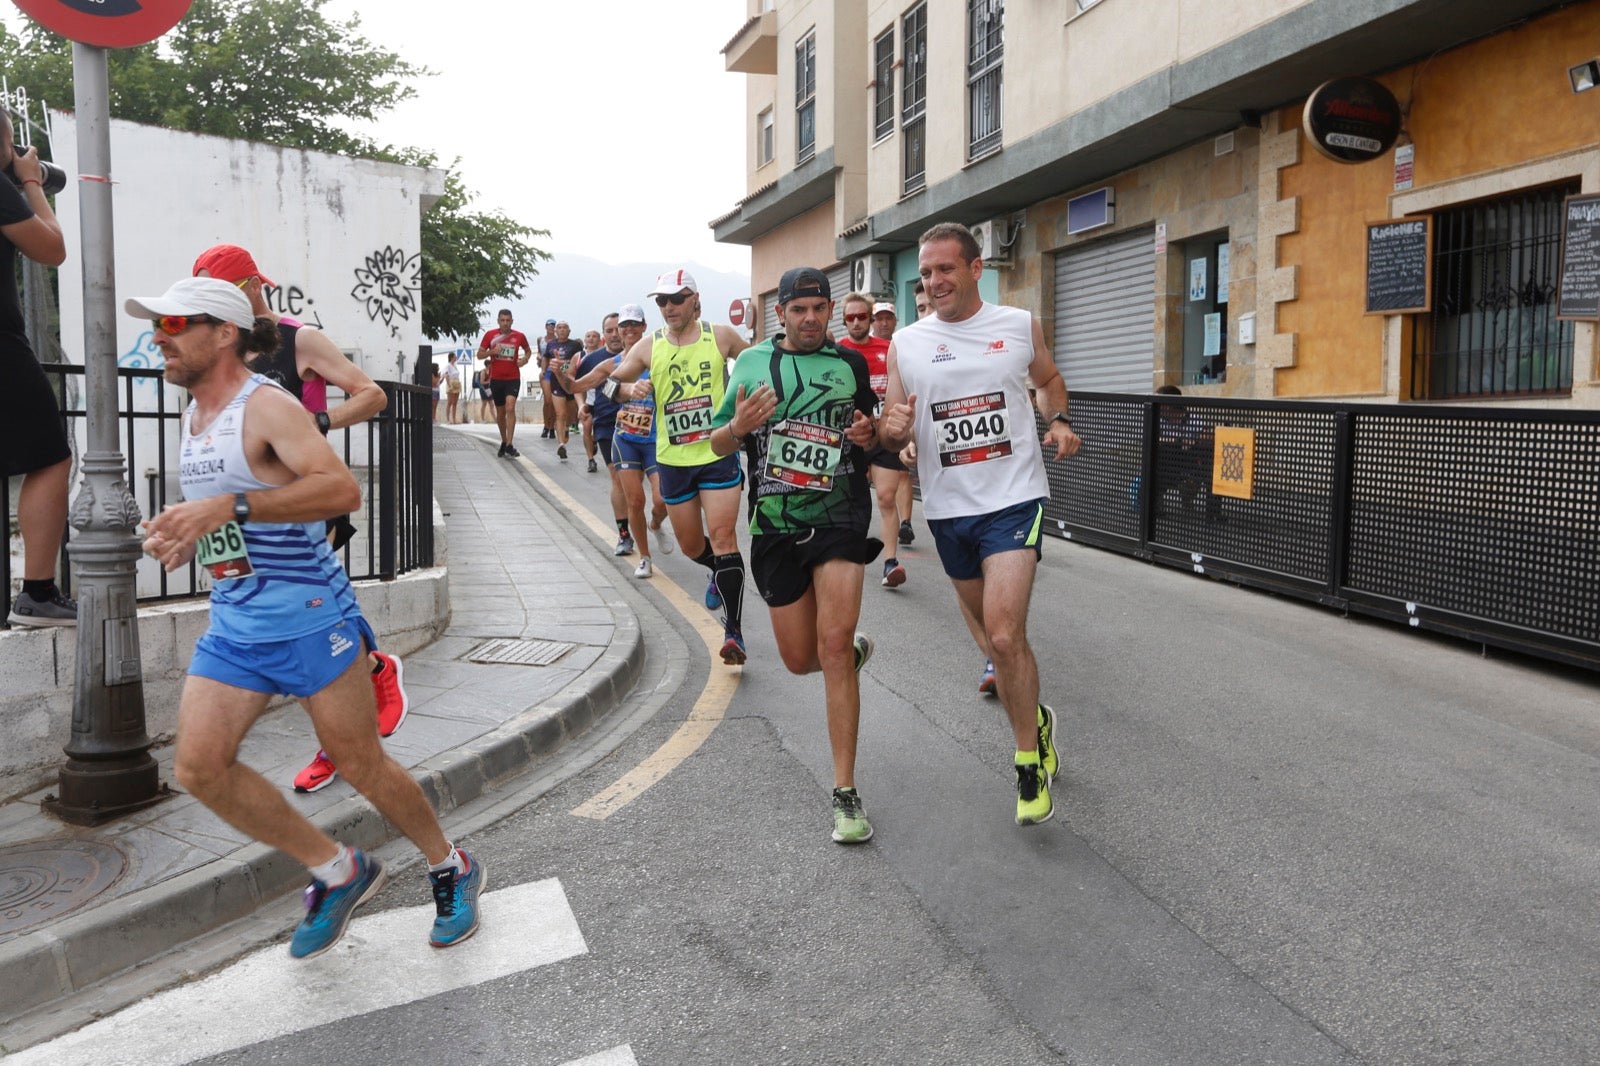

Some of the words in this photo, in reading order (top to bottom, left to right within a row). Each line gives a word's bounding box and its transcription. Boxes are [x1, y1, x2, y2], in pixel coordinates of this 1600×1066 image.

[622, 412, 650, 427] 2112
[669, 409, 712, 432] 1041
[944, 414, 1004, 444] 3040
[781, 441, 829, 471] 648
